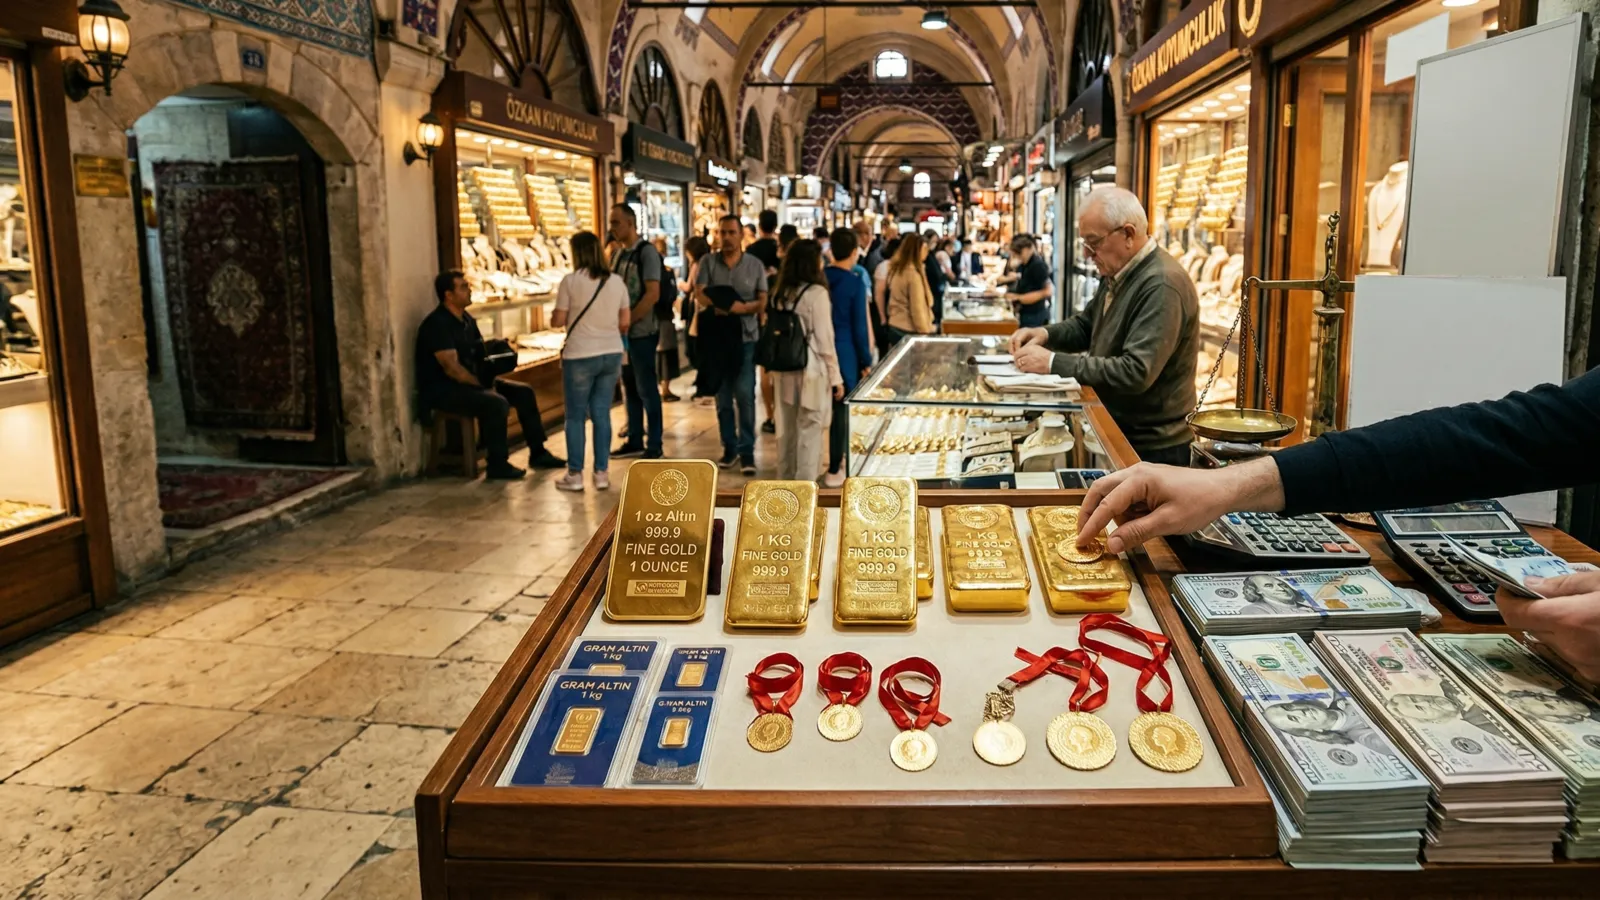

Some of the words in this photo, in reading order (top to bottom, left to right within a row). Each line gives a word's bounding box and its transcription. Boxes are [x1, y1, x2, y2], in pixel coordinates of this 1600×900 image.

[1131, 52, 1157, 94] ÖZKAN
[1157, 0, 1226, 76] KUYUMCULUK
[506, 92, 542, 127] ÖZKAN
[635, 510, 642, 522] 1
[645, 512, 662, 522] oz
[645, 526, 681, 538] 999.9
[862, 530, 869, 543] 1
[873, 530, 896, 543] KG
[977, 532, 998, 540] KG
[757, 534, 764, 546] 1
[769, 534, 792, 546] KG
[625, 543, 656, 555] FINE
[660, 543, 697, 555] GOLD
[847, 548, 873, 558] FINE
[875, 548, 908, 558] GOLD
[742, 550, 768, 561] FINE
[770, 551, 802, 561] GOLD
[629, 561, 637, 573] 1
[640, 561, 689, 573] OUNCE
[752, 565, 789, 577] 999.9
[857, 562, 896, 574] 999.9
[583, 644, 616, 652] GRAM
[609, 653, 623, 661] kg
[560, 681, 596, 690] GRAM
[596, 682, 632, 690] ALTIN
[581, 691, 587, 699] 1
[588, 691, 603, 701] kg
